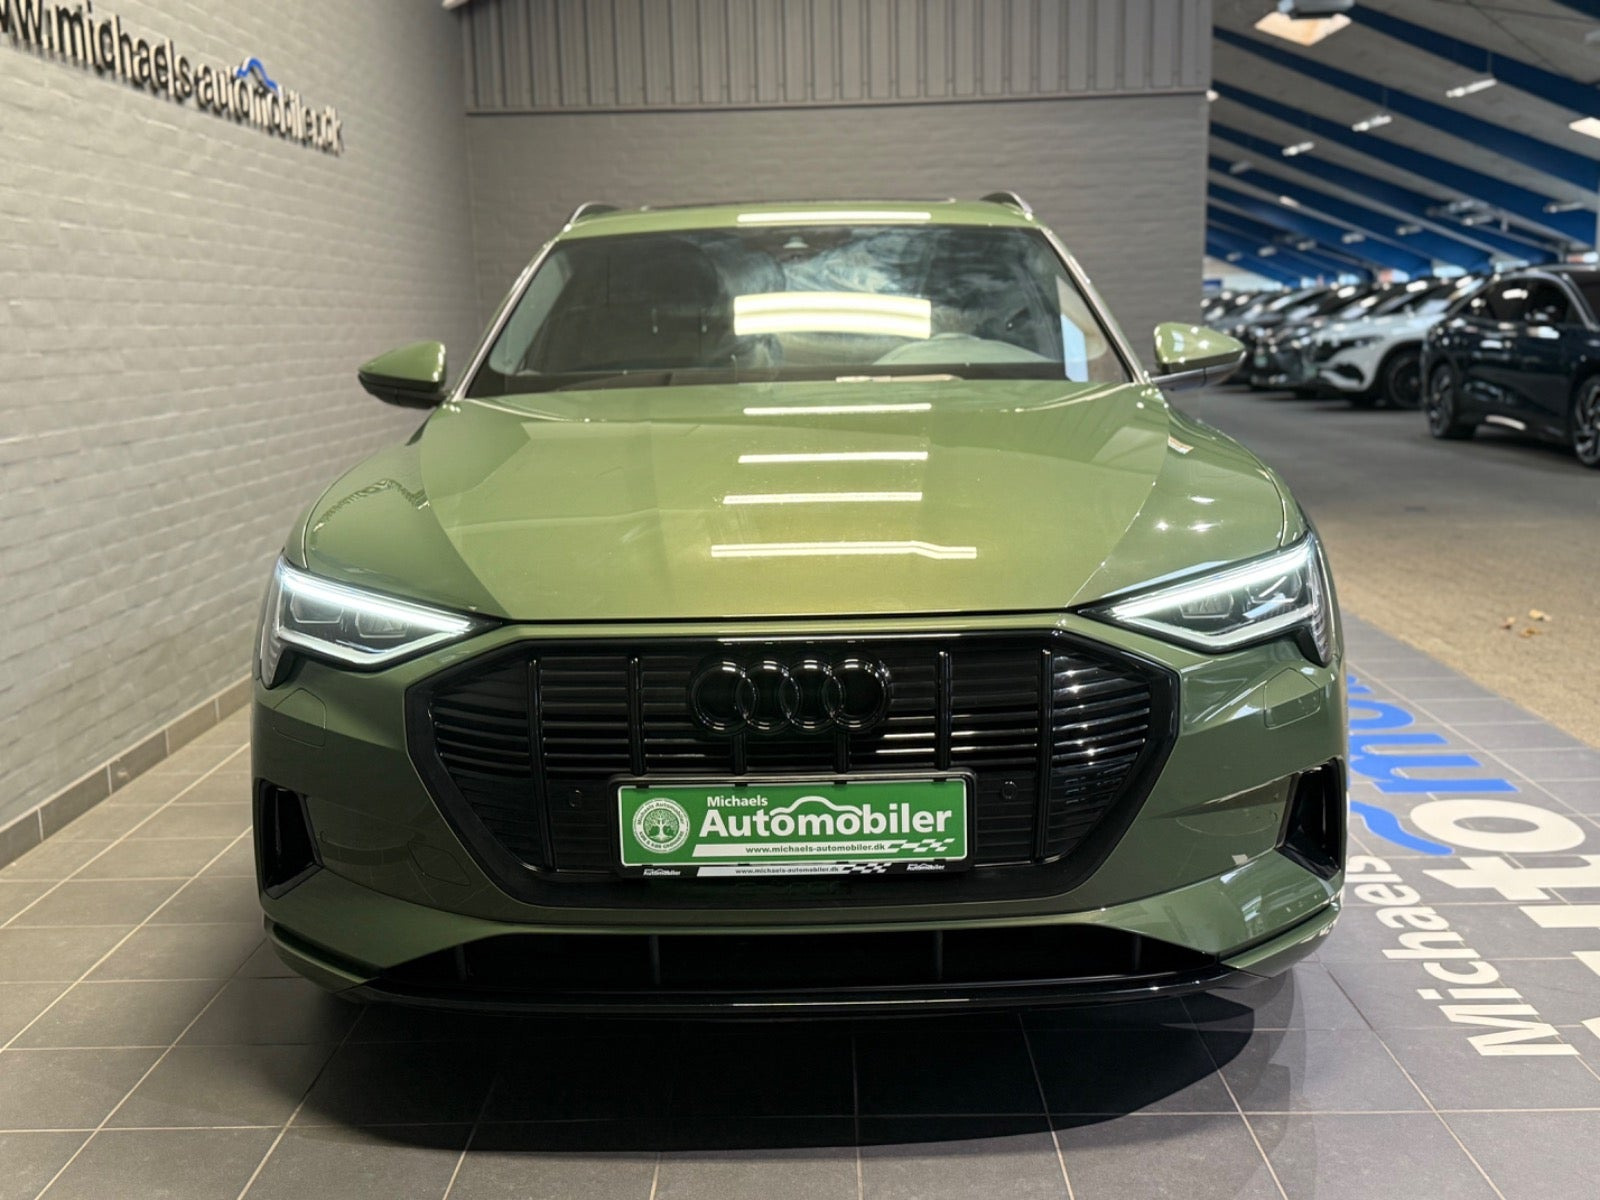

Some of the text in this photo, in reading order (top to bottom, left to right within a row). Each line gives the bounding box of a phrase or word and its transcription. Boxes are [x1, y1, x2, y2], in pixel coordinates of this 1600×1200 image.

[707, 795, 768, 808] Michaels
[699, 803, 952, 838] Automobiler
[745, 843, 885, 854] www.michaels-automobiler.dk
[1345, 855, 1580, 1056] Michaels
